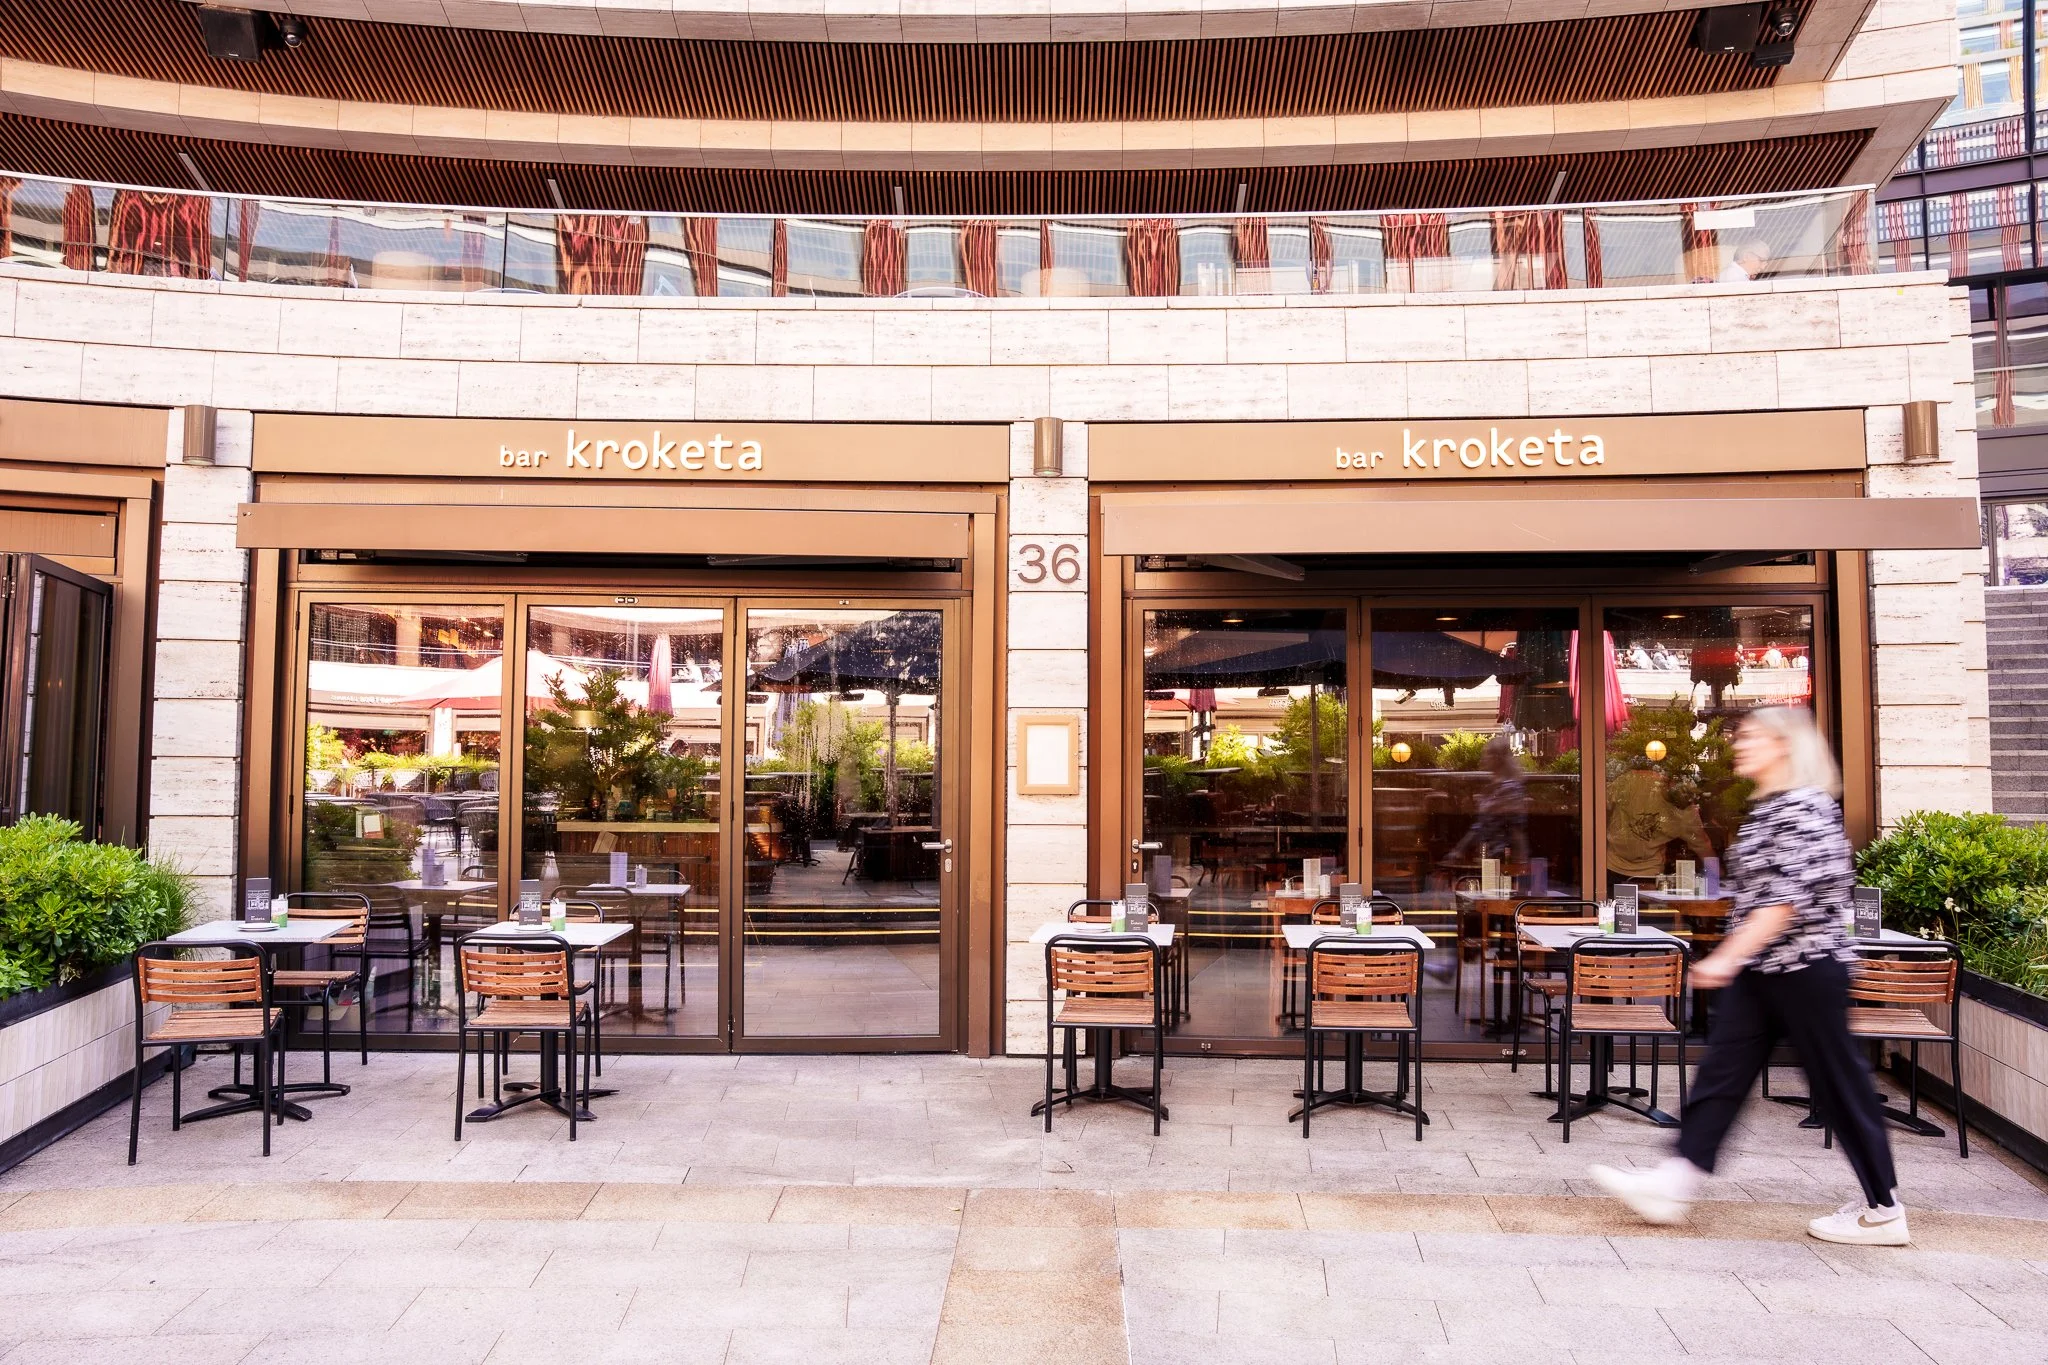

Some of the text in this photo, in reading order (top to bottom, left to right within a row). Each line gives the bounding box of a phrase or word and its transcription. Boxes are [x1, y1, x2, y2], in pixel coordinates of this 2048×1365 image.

[499, 429, 764, 471] bar kroketa
[1335, 427, 1606, 469] bar kroketa
[1017, 543, 1081, 584] 36
